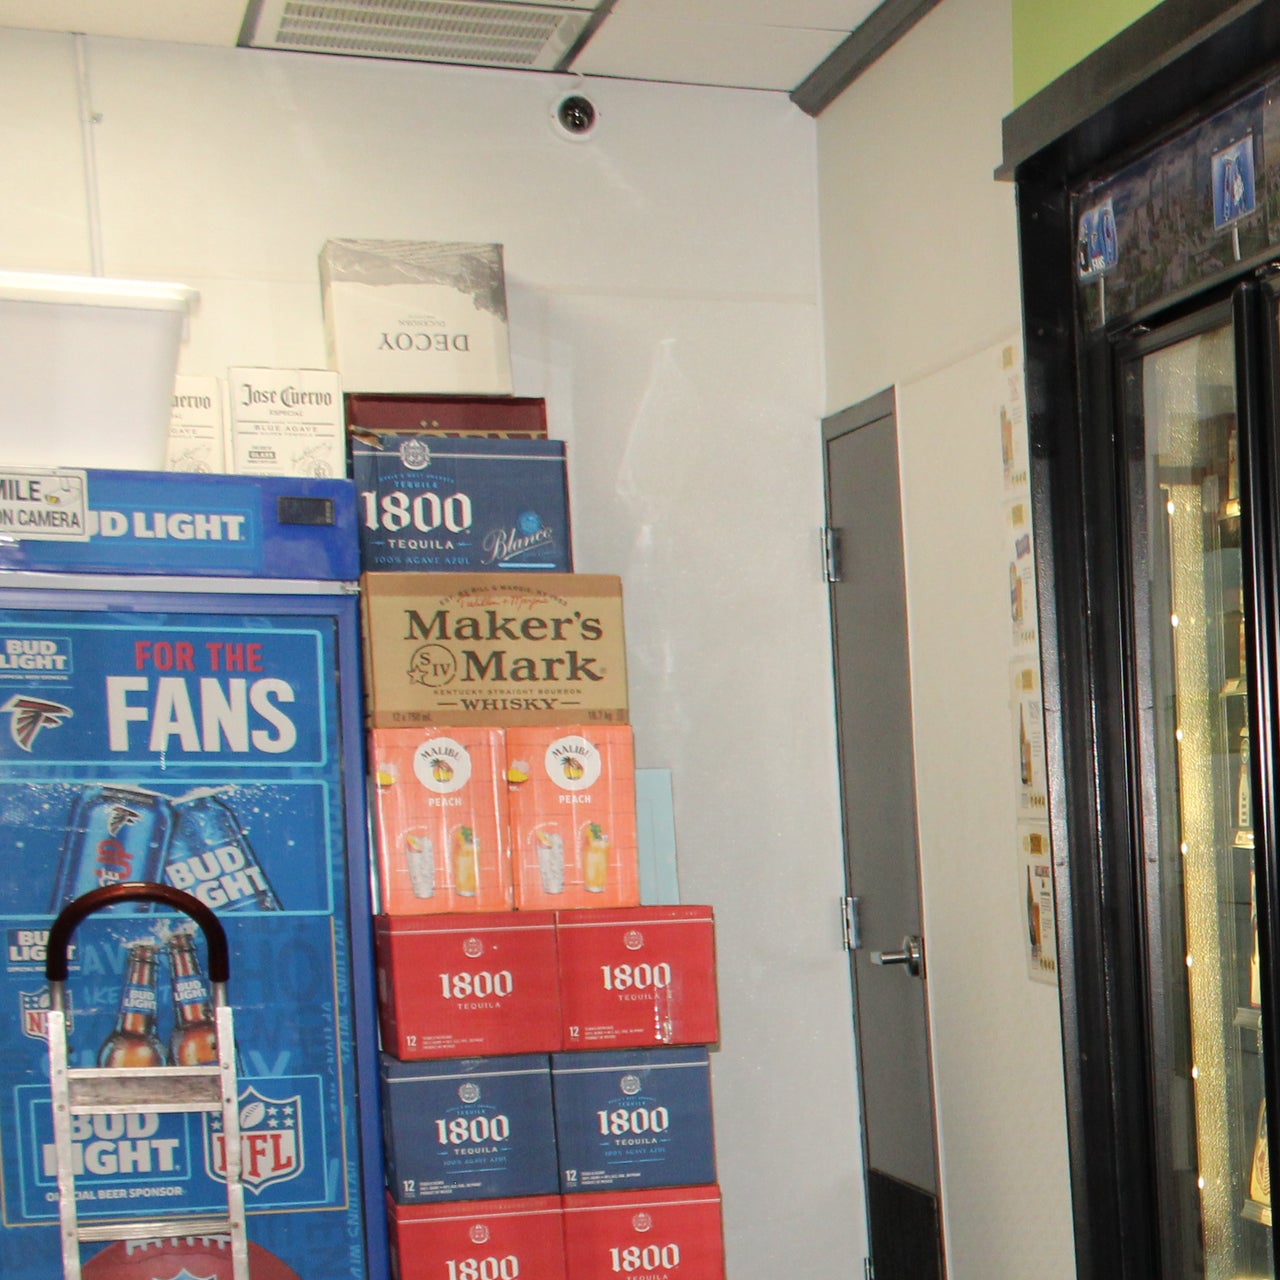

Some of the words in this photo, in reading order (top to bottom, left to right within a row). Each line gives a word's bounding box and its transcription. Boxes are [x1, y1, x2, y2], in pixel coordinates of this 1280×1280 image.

[379, 333, 470, 352] DECOY
[241, 383, 278, 407] Jose
[280, 384, 333, 408] Cuervo
[18, 511, 81, 528] CAMERA
[362, 491, 472, 533] 1800
[132, 512, 245, 541] LIGHT
[388, 539, 455, 550] TEQUILA
[481, 526, 553, 566] Blanco
[404, 610, 603, 641] Maker's
[7, 640, 57, 655] BUD
[135, 641, 195, 671] FOR
[206, 643, 264, 672] THE
[0, 655, 67, 670] LIGHT
[460, 650, 606, 682] Mark
[106, 676, 297, 754] FANS
[460, 698, 559, 710] WHISKY
[420, 746, 462, 761] MALIBU
[552, 744, 593, 759] MALIBU
[428, 798, 462, 807] PEACH
[559, 795, 592, 804] PEACH
[166, 846, 245, 884] BUD
[439, 970, 513, 999] 1800
[601, 962, 672, 991] 1800
[407, 1035, 417, 1046] 12
[435, 1115, 510, 1145] 1800
[597, 1106, 669, 1136] 1800
[454, 1146, 498, 1156] TEQUILA
[98, 1187, 128, 1199] BEER
[131, 1187, 184, 1198] SPONSOR
[610, 1243, 681, 1272] 1800
